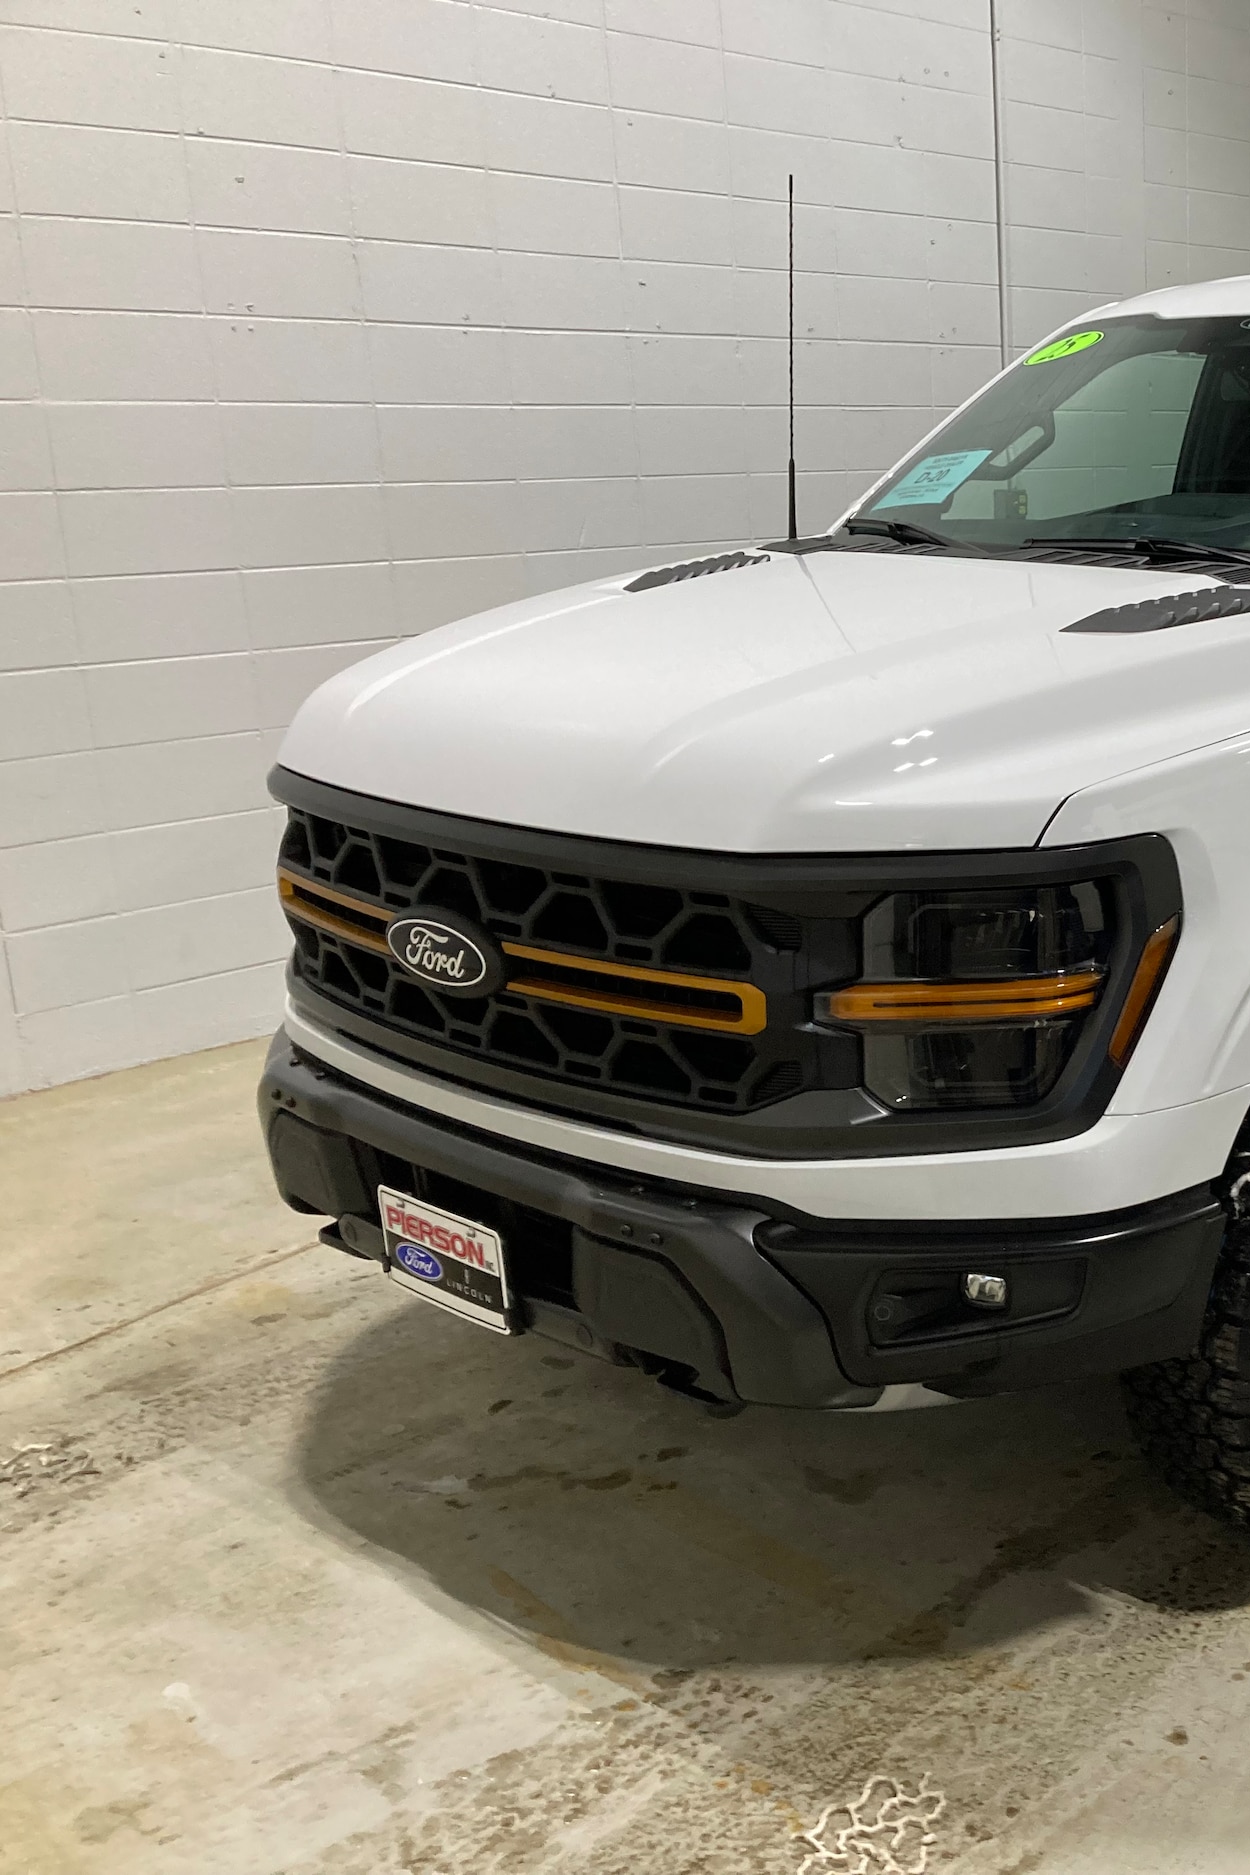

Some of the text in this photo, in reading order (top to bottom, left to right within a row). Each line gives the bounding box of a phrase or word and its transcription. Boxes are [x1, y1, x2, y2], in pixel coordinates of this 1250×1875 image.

[405, 926, 465, 979] Ford
[385, 1204, 486, 1269] PIERSON
[404, 1247, 434, 1275] Ford
[446, 1278, 493, 1304] LINCOLN
